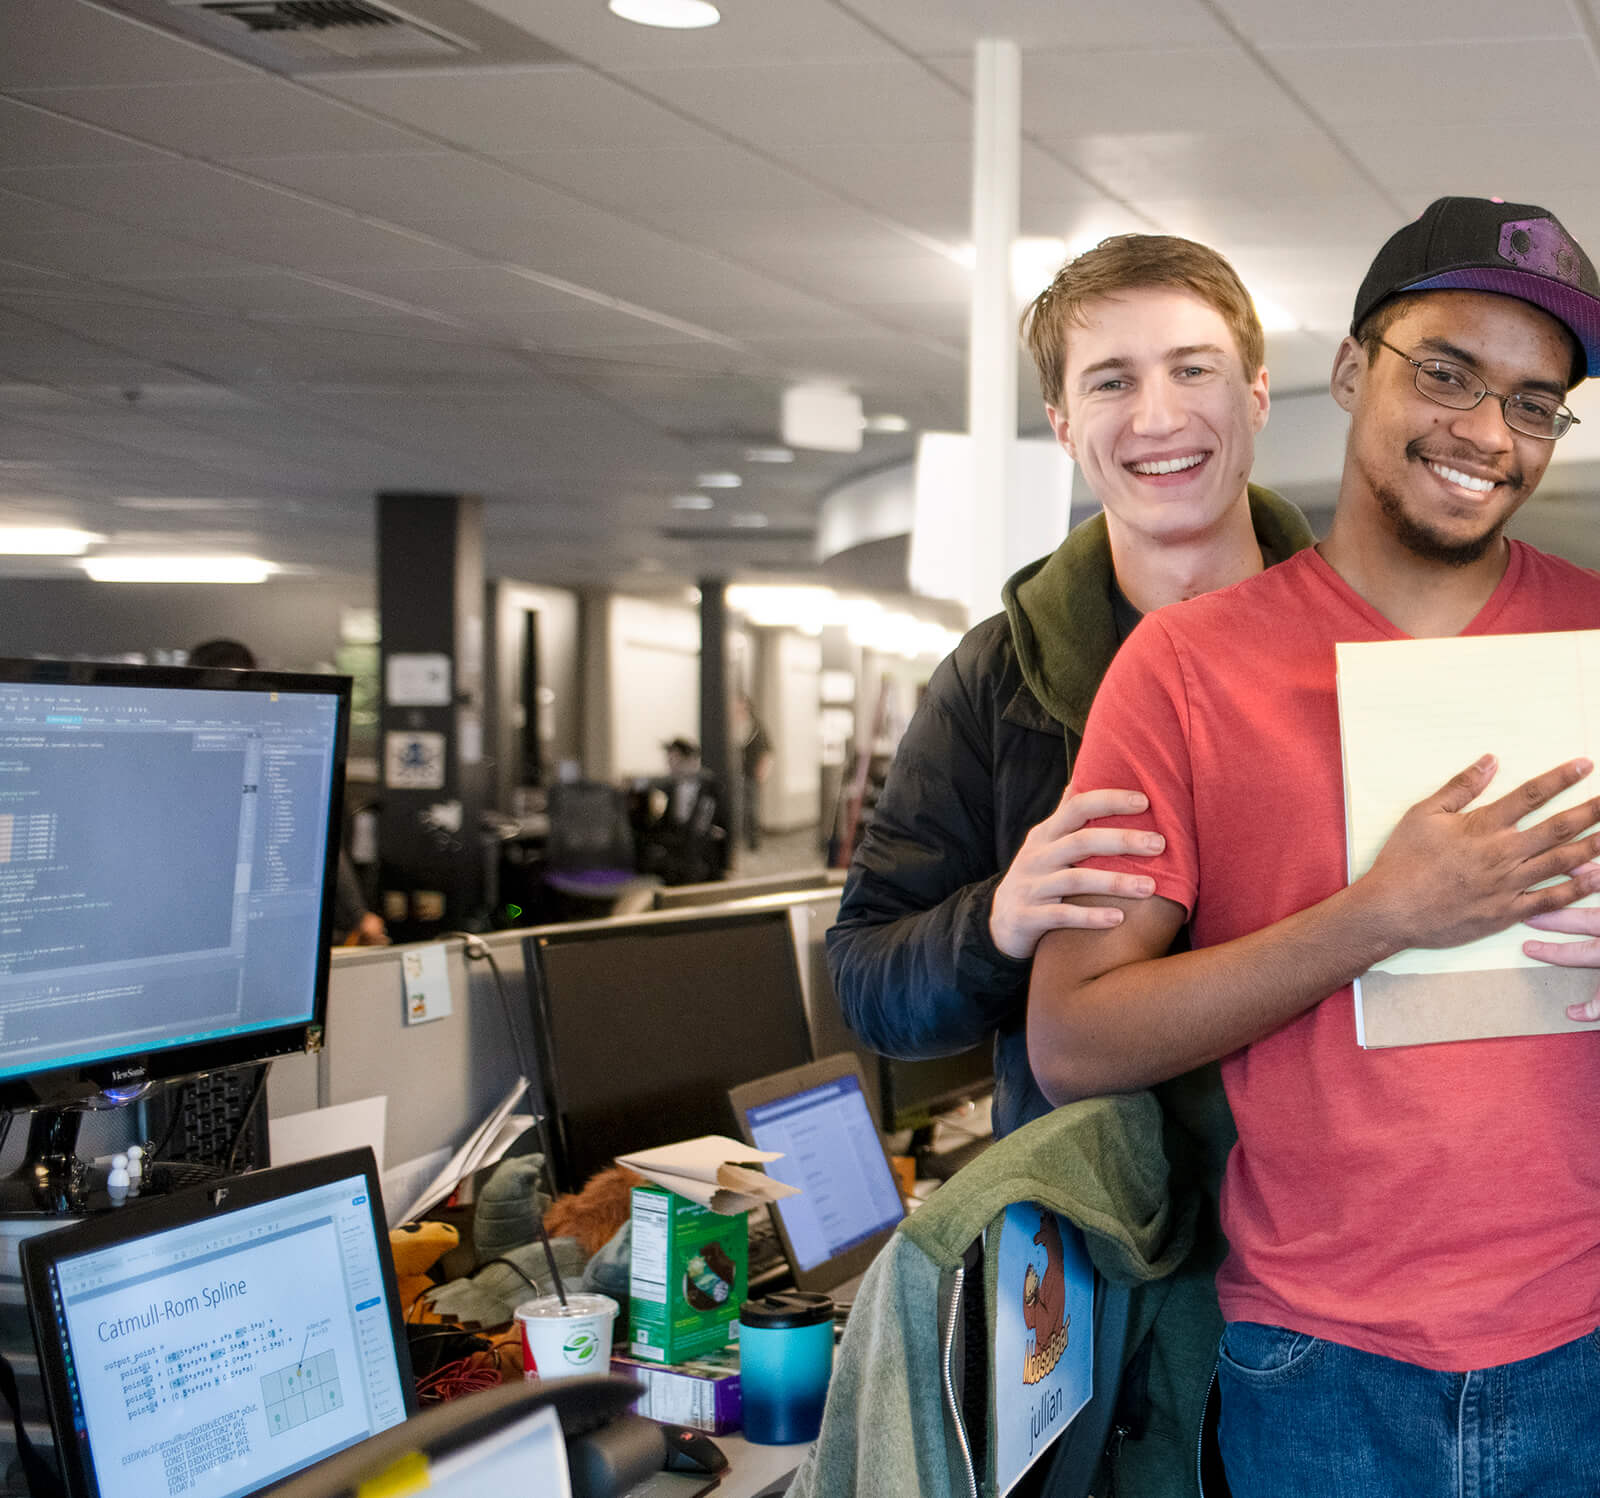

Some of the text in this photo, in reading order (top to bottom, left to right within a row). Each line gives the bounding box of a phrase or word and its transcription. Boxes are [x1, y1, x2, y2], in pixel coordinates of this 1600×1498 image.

[112, 1066, 145, 1080] ViewSonic
[97, 1280, 247, 1342] Catmull-Rom Spline
[1023, 1314, 1071, 1385] MooseBear
[104, 1347, 156, 1371] output_point
[1029, 1387, 1063, 1456] jullian
[162, 1444, 183, 1459] CONST
[164, 1452, 185, 1468] CONST
[166, 1461, 187, 1477] CONST
[167, 1471, 189, 1486] CONST
[169, 1481, 189, 1496] FLOAT
